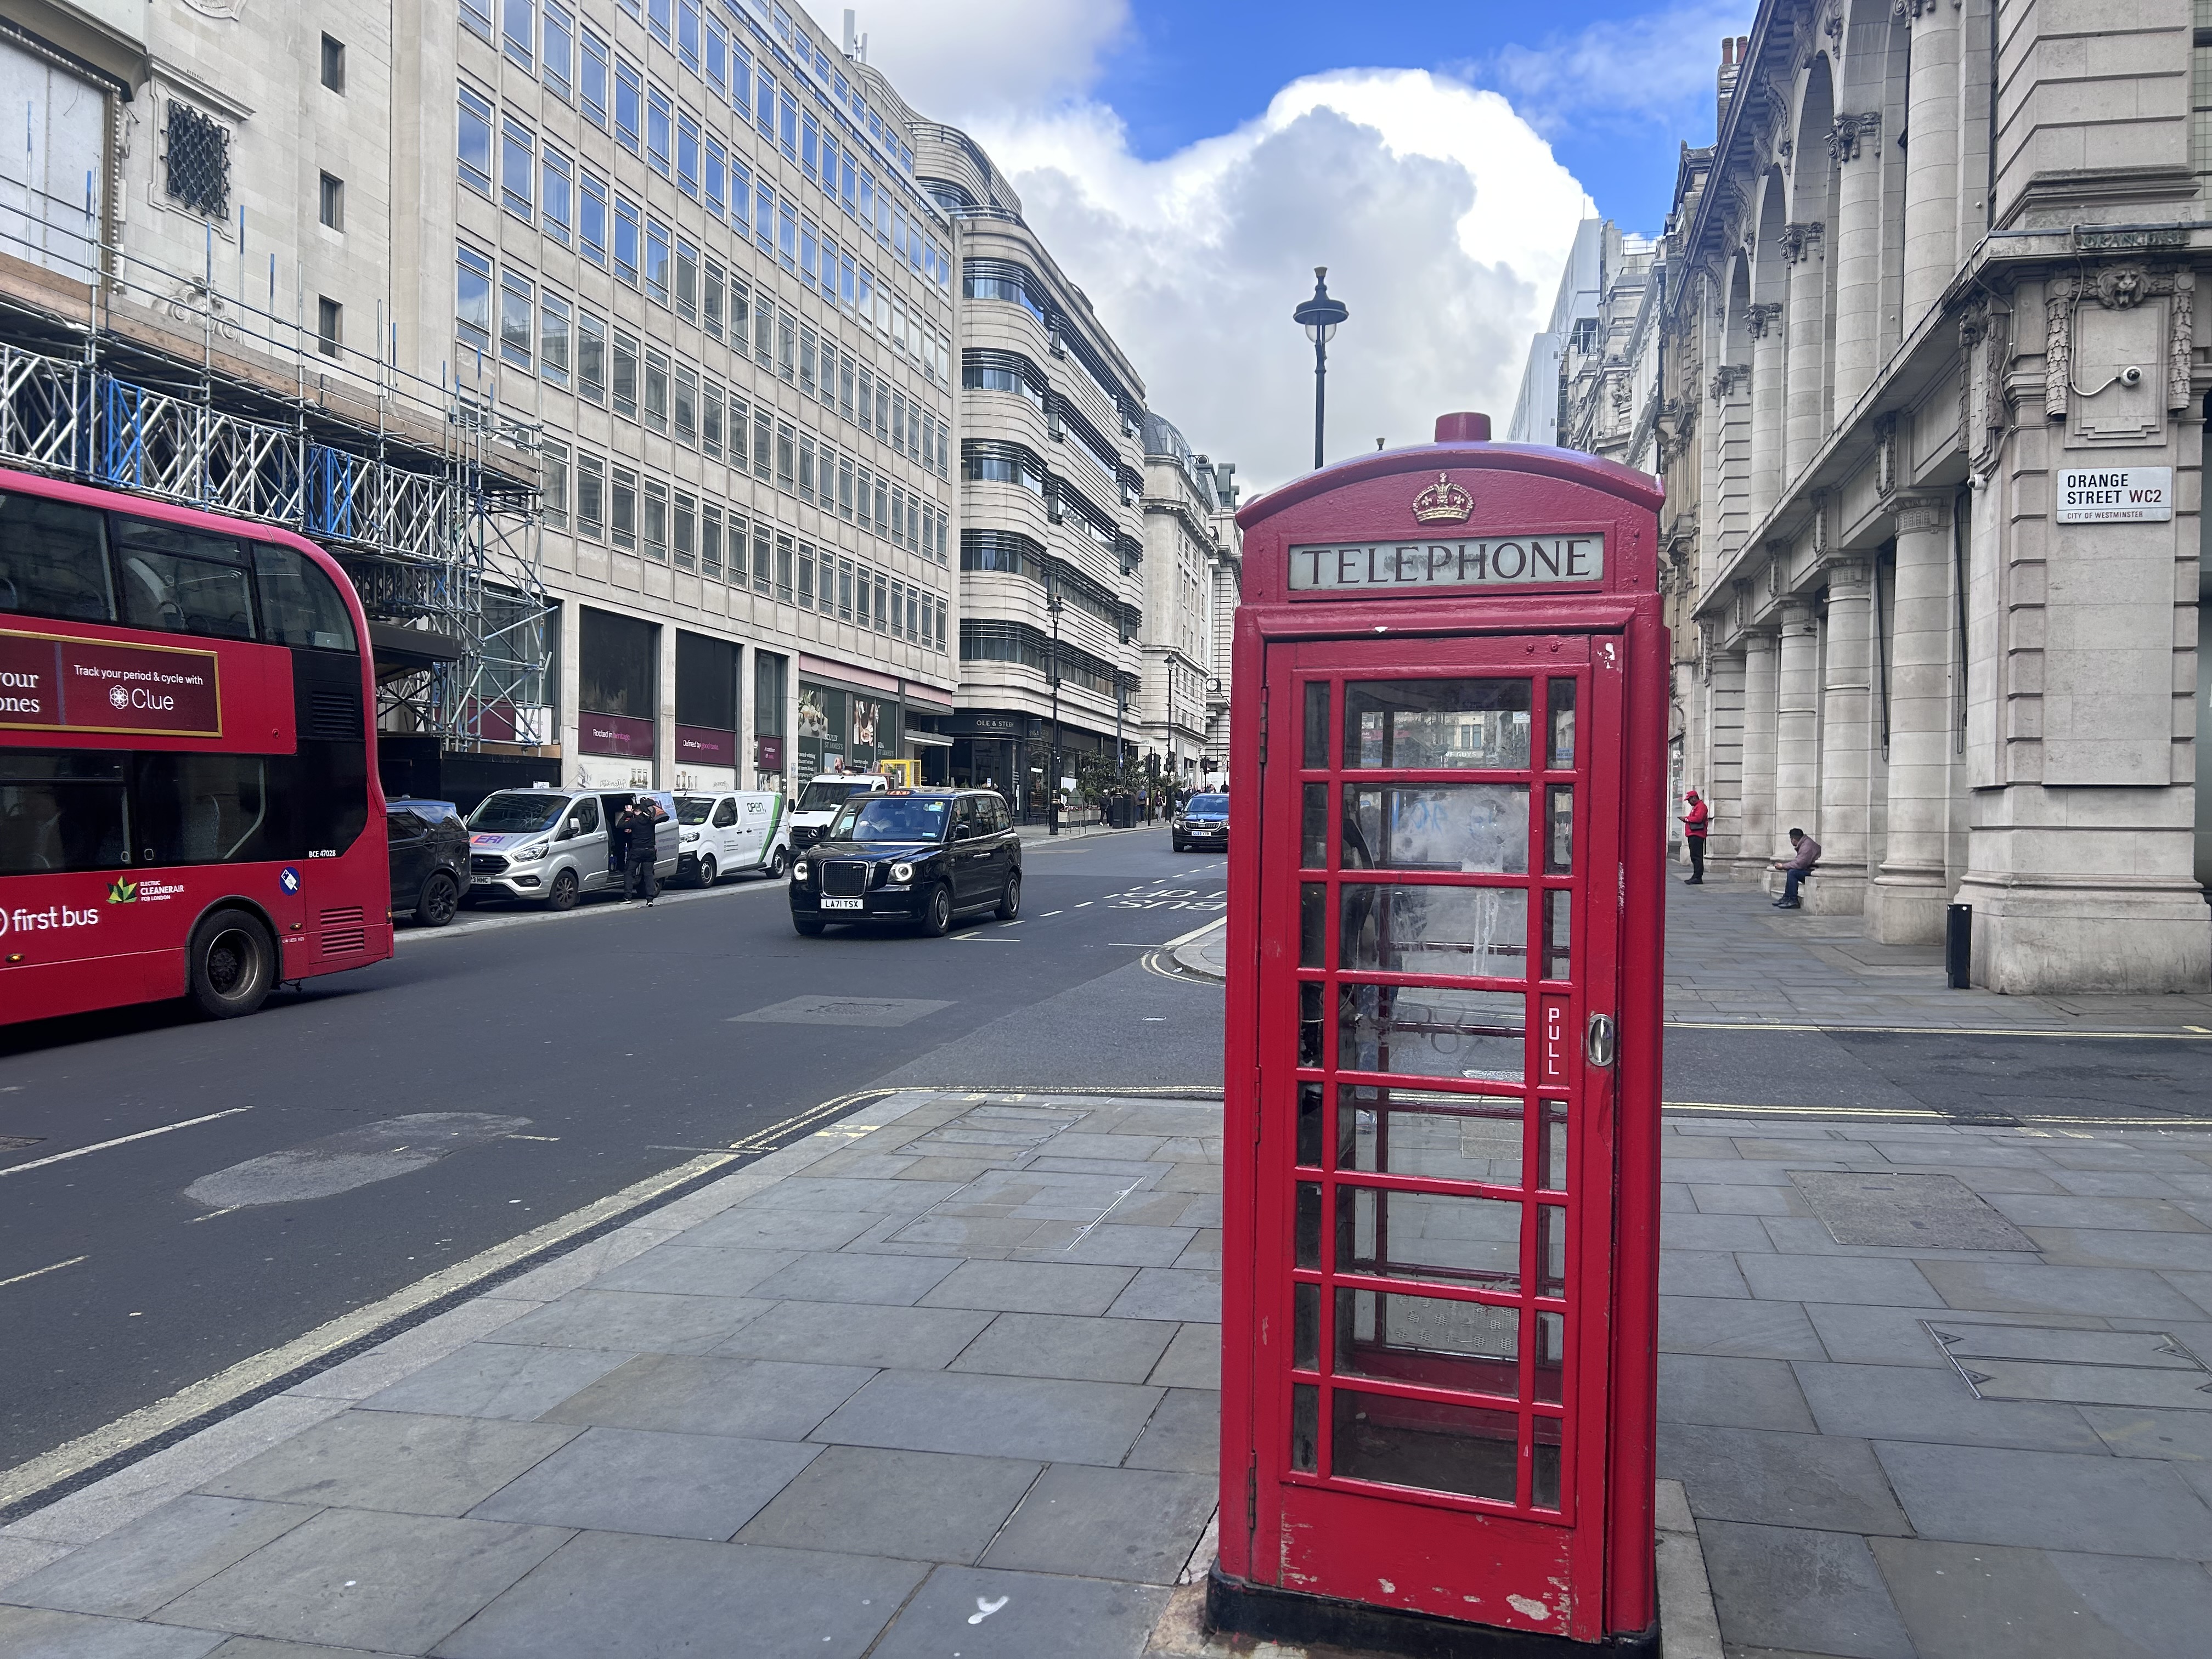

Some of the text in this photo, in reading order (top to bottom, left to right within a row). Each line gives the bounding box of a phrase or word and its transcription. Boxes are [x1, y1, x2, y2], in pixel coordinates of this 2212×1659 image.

[2067, 474, 2129, 488] ORANGE
[2067, 489, 2162, 504] STREET WC2
[1301, 539, 1591, 584] TELEPHONE
[0, 672, 40, 688] our
[74, 664, 203, 685] Track your period & cycle with
[131, 688, 174, 710] Clue
[474, 835, 506, 844] ERI
[1107, 900, 1227, 911] BUS
[12, 905, 99, 932] first bus
[1548, 1007, 1560, 1075] PULL
